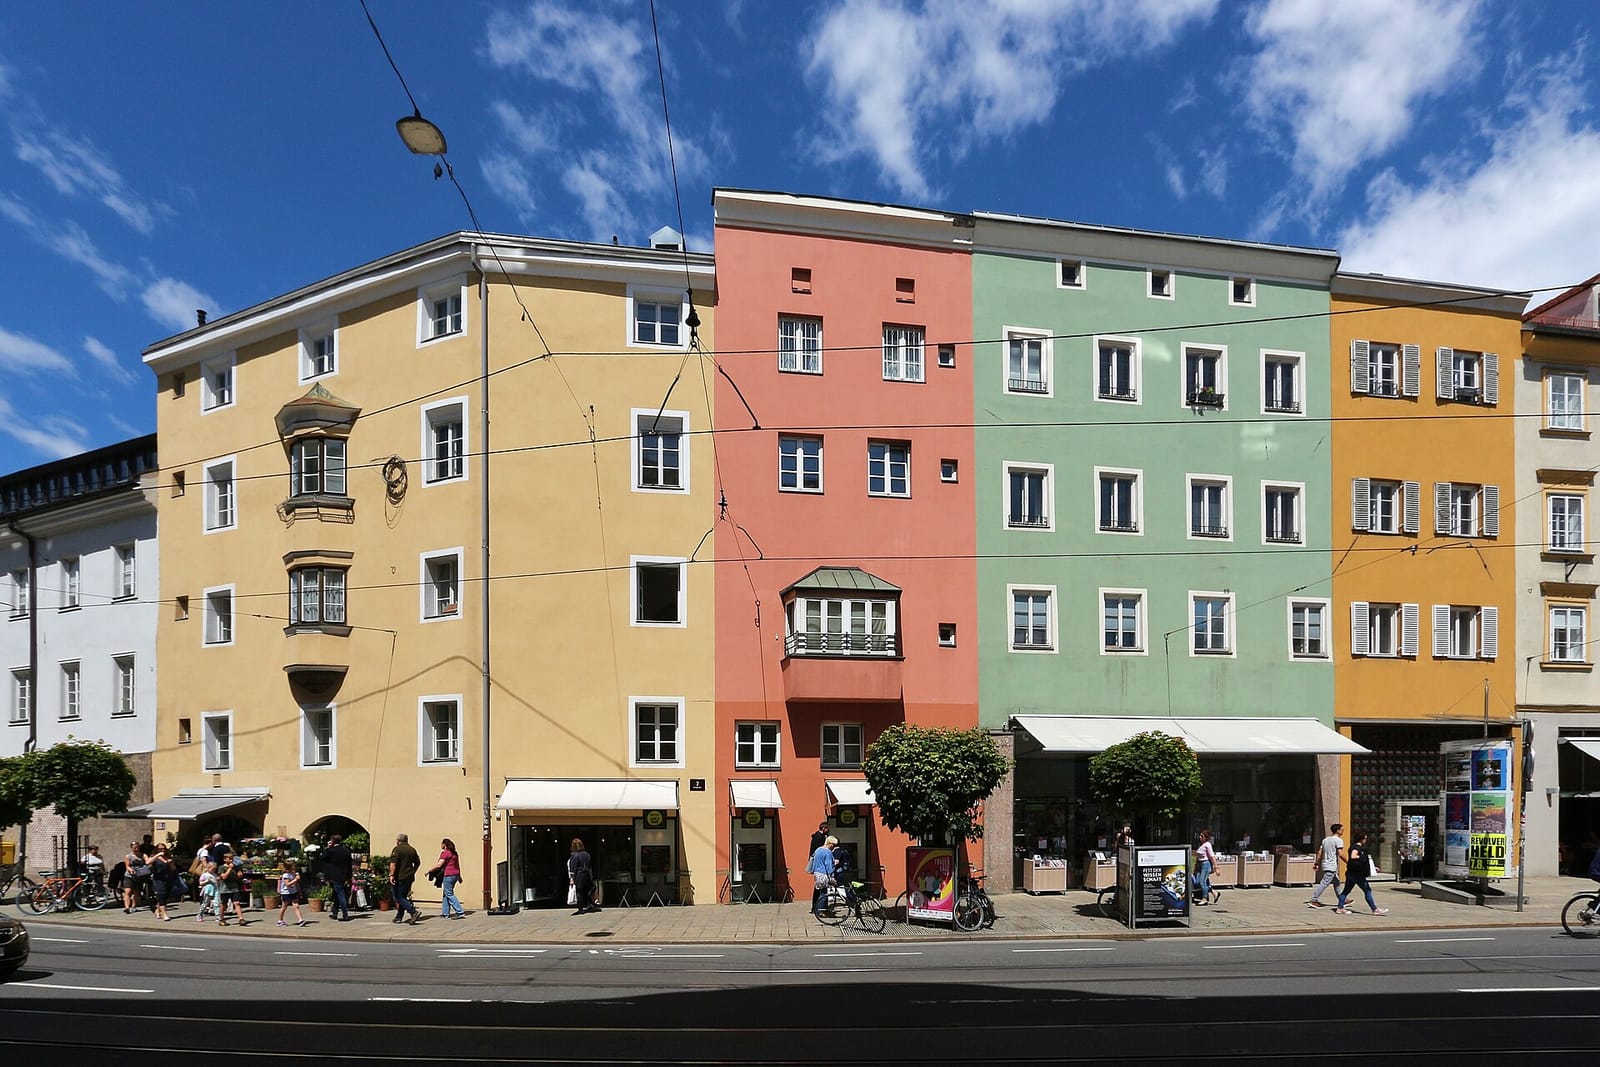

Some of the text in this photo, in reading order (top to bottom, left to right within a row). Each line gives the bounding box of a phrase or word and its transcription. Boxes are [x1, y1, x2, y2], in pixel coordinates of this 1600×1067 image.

[1471, 837, 1504, 846] REVOLVER
[1471, 846, 1504, 858] HELD
[1470, 859, 1486, 870] 7.8.
